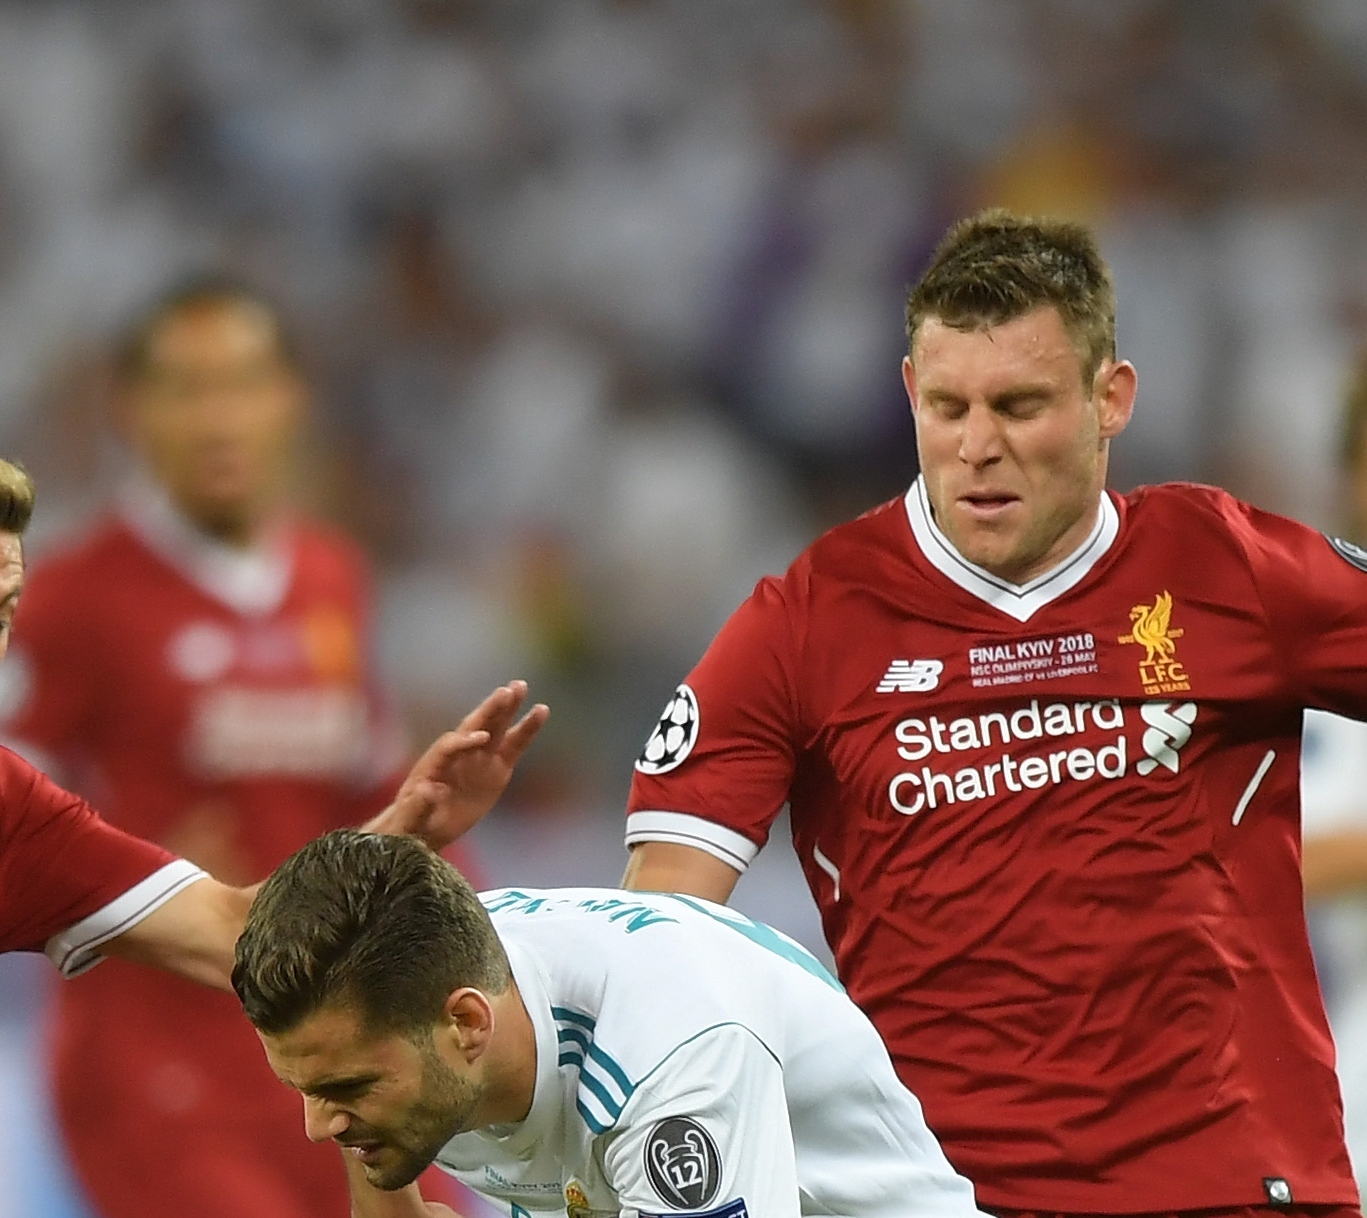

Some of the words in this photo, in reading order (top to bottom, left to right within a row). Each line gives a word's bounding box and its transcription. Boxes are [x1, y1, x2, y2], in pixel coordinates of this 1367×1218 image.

[969, 645, 1015, 664] FINAL
[1016, 640, 1054, 659] KYIV
[1058, 633, 1094, 653] 2018
[1074, 651, 1096, 663] MAY
[895, 699, 1124, 760] Standard
[889, 735, 1127, 815] Chartered
[671, 1161, 702, 1189] 12
